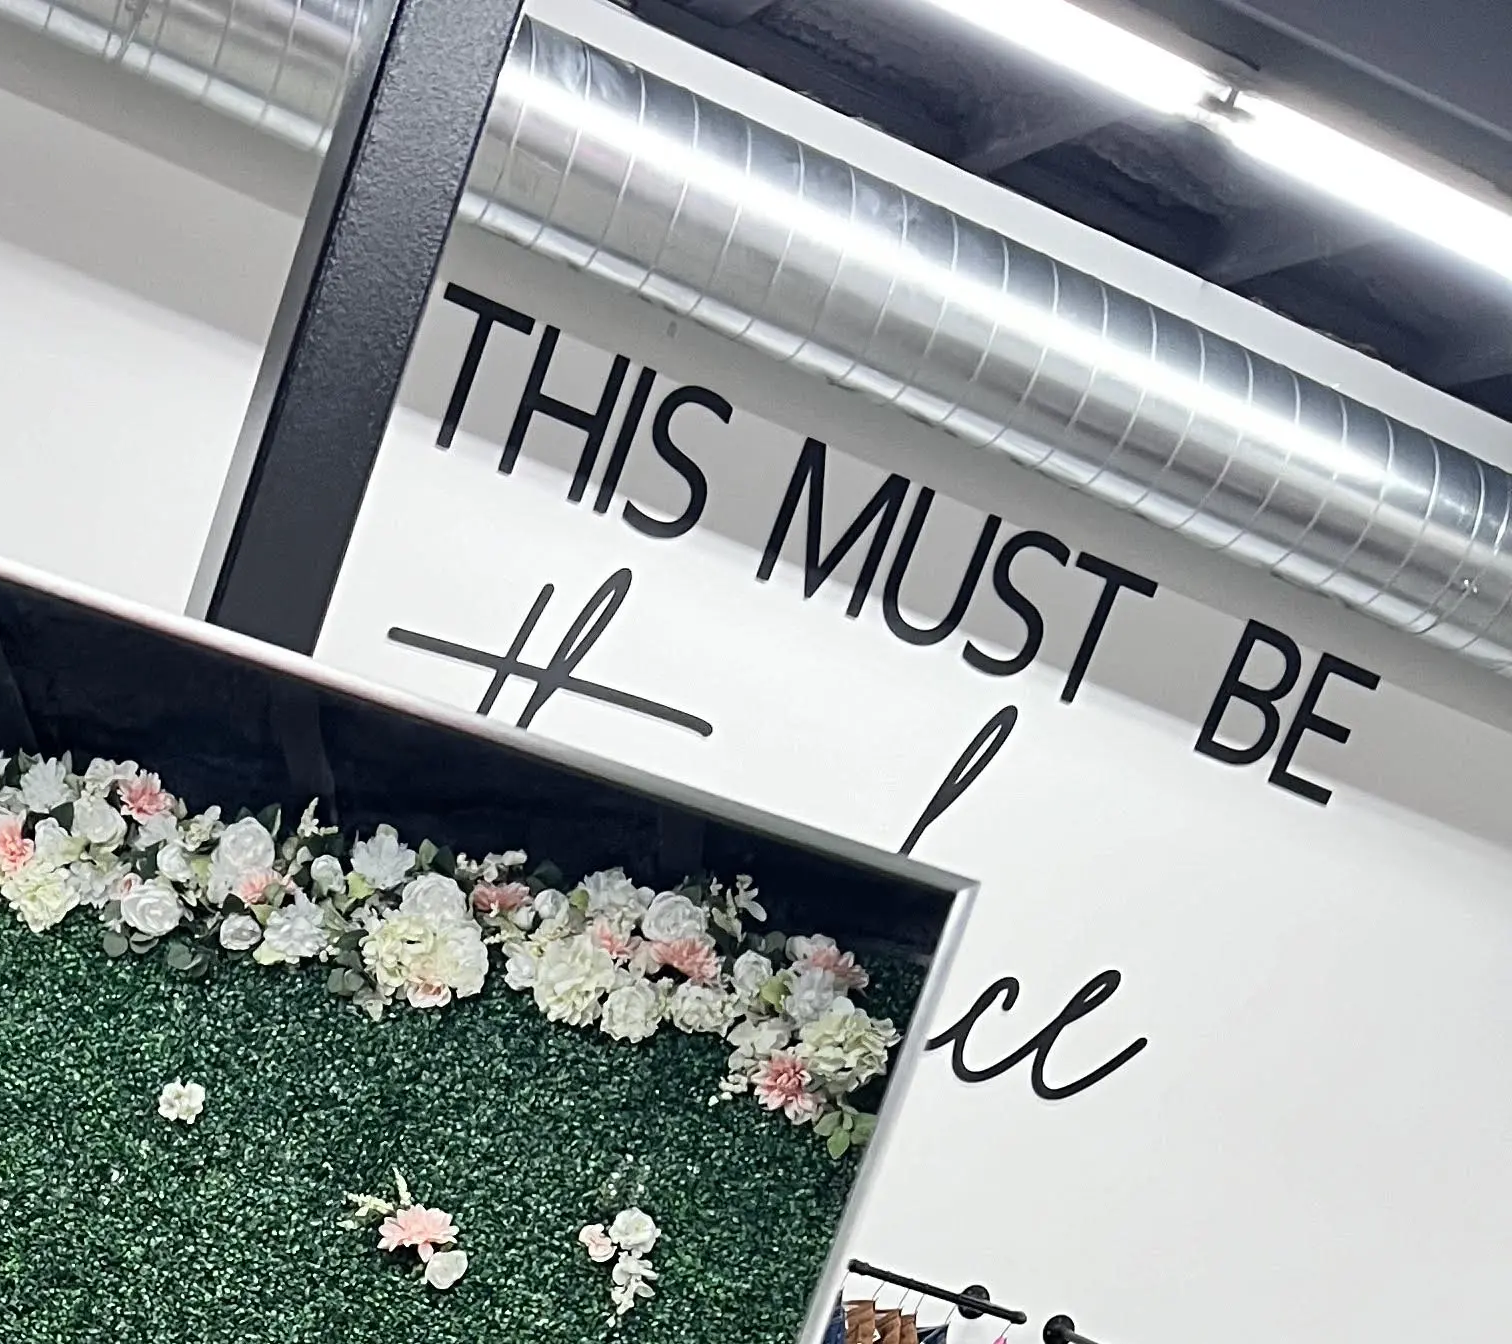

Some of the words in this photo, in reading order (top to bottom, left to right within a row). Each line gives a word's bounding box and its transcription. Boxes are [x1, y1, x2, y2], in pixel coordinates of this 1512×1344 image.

[437, 281, 734, 540] THIS
[755, 438, 1156, 704] MUST
[1194, 618, 1381, 805] BE
